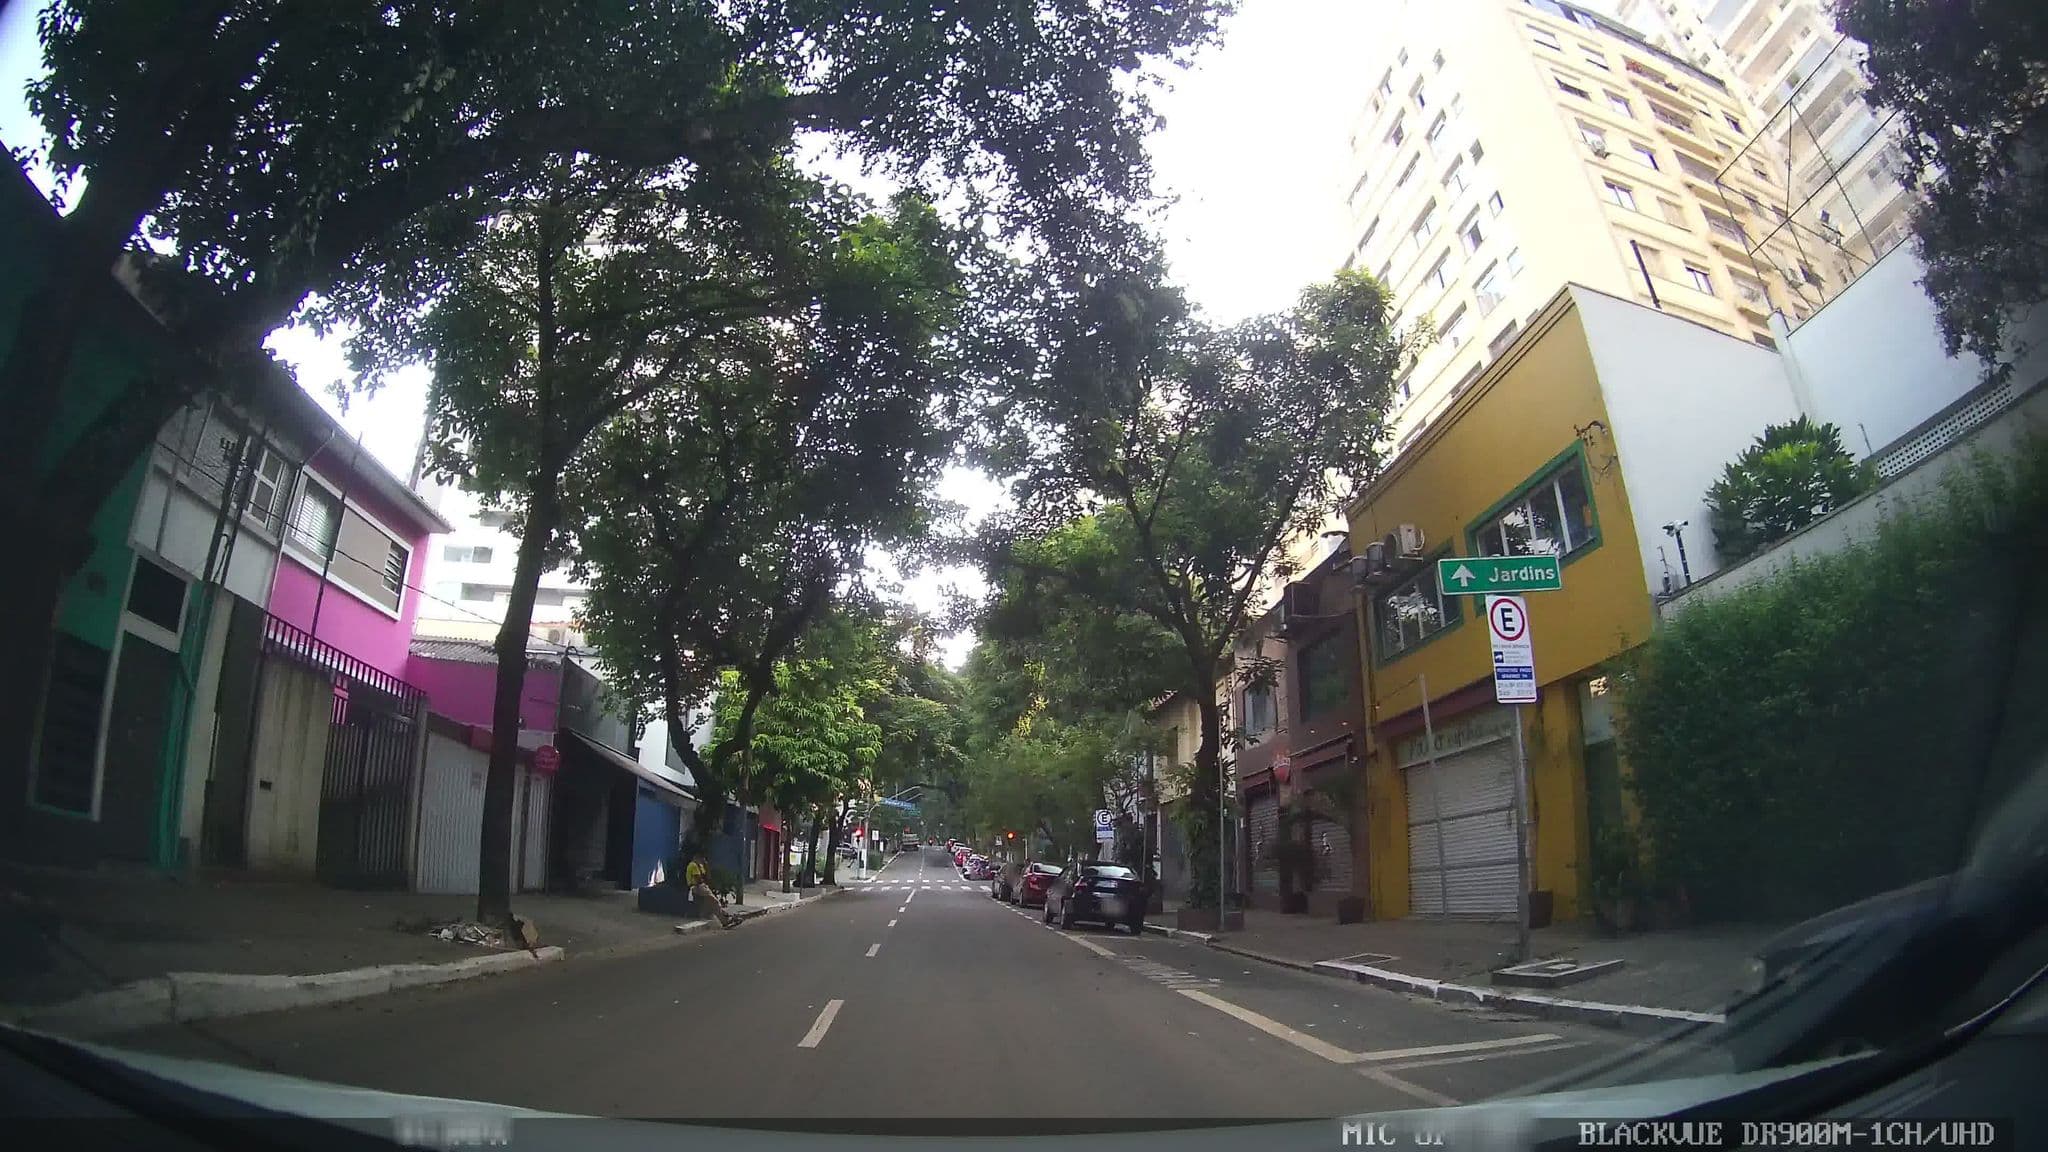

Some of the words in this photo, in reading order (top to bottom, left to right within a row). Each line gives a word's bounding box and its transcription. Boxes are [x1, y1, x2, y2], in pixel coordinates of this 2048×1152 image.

[1489, 566, 1555, 583] Jardins
[1500, 608, 1515, 632] E
[1102, 814, 1108, 823] E
